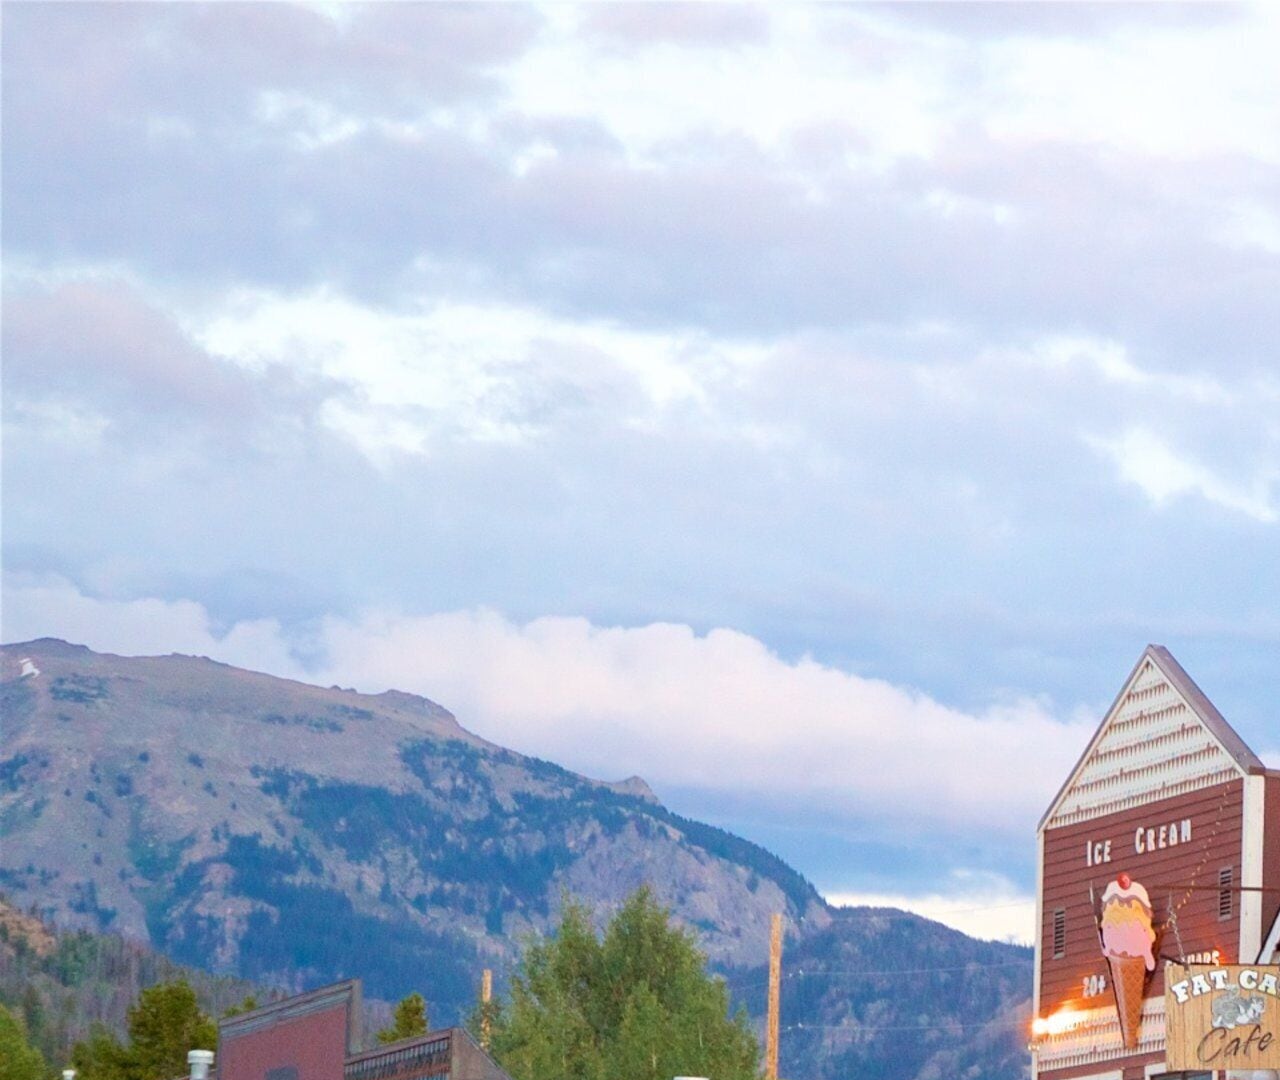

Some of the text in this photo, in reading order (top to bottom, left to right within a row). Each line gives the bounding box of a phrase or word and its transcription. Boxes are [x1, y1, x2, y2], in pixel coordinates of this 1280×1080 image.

[1086, 818, 1193, 867] ICE CREAM
[1171, 969, 1229, 1004] FAT
[1197, 1025, 1276, 1063] Cafe
